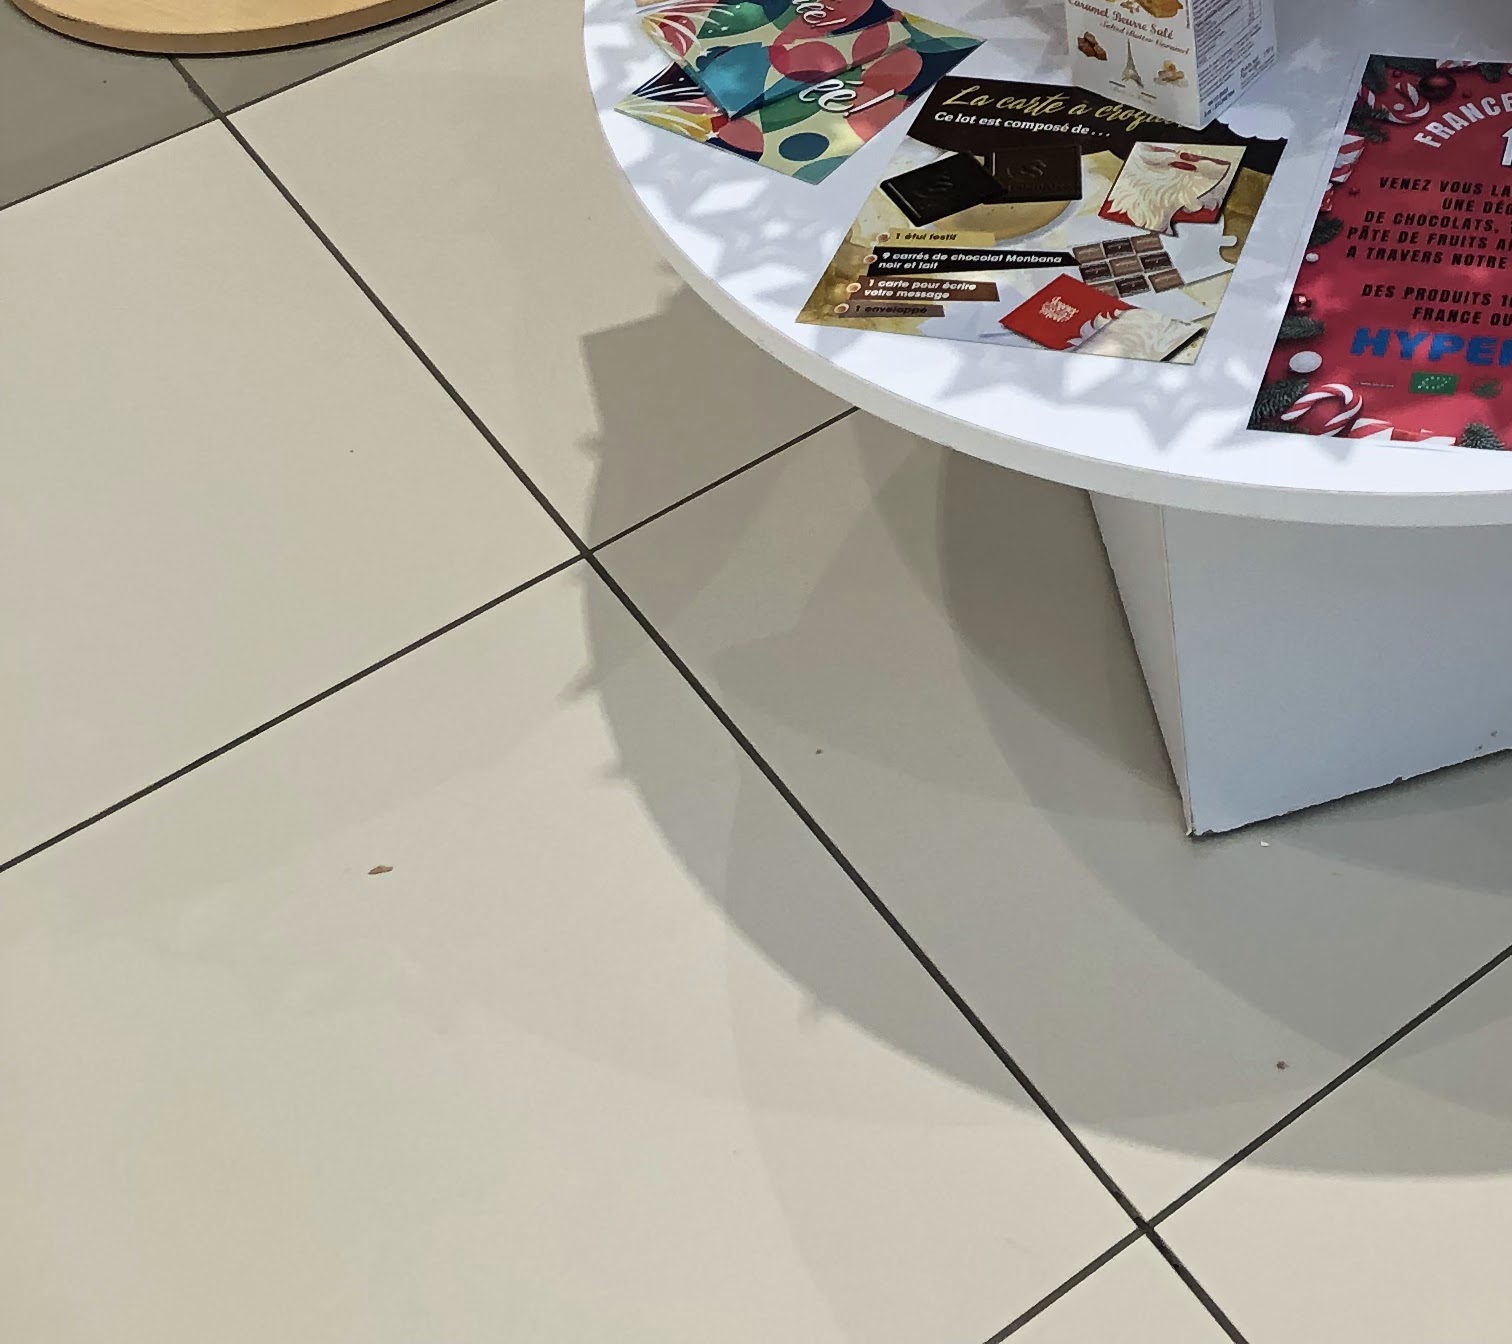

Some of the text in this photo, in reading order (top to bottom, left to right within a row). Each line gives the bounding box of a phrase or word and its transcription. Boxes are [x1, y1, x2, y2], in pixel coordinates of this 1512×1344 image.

[1113, 10, 1147, 31] Beurre
[1150, 24, 1173, 40] Salé
[942, 85, 1094, 117] La carte à
[934, 111, 954, 123] Ce
[954, 112, 977, 124] lot
[978, 115, 1001, 128] est
[1002, 116, 1069, 134] composé
[1379, 176, 1432, 192] VENEZ
[1440, 180, 1483, 195] VOUS
[1442, 198, 1474, 212] UNE
[1364, 210, 1385, 224] DE
[905, 231, 928, 241] étui
[929, 232, 957, 241] festif
[1346, 226, 1391, 243] PÂTE
[1398, 230, 1420, 245] DE
[1427, 232, 1488, 250] FRUITS
[878, 260, 938, 270] noir et lait
[892, 252, 1063, 263] carrés de chocolat Monbana
[1345, 246, 1358, 258] A
[1367, 247, 1443, 265] TRAVERS
[1451, 253, 1507, 270] NOTRE
[864, 288, 951, 300] votre message
[877, 279, 910, 289] carte
[912, 281, 941, 291] pour
[942, 281, 977, 291] écrire
[1361, 284, 1395, 299] DES
[1403, 287, 1491, 306] PRODUITS
[1412, 307, 1481, 325] FRANCE
